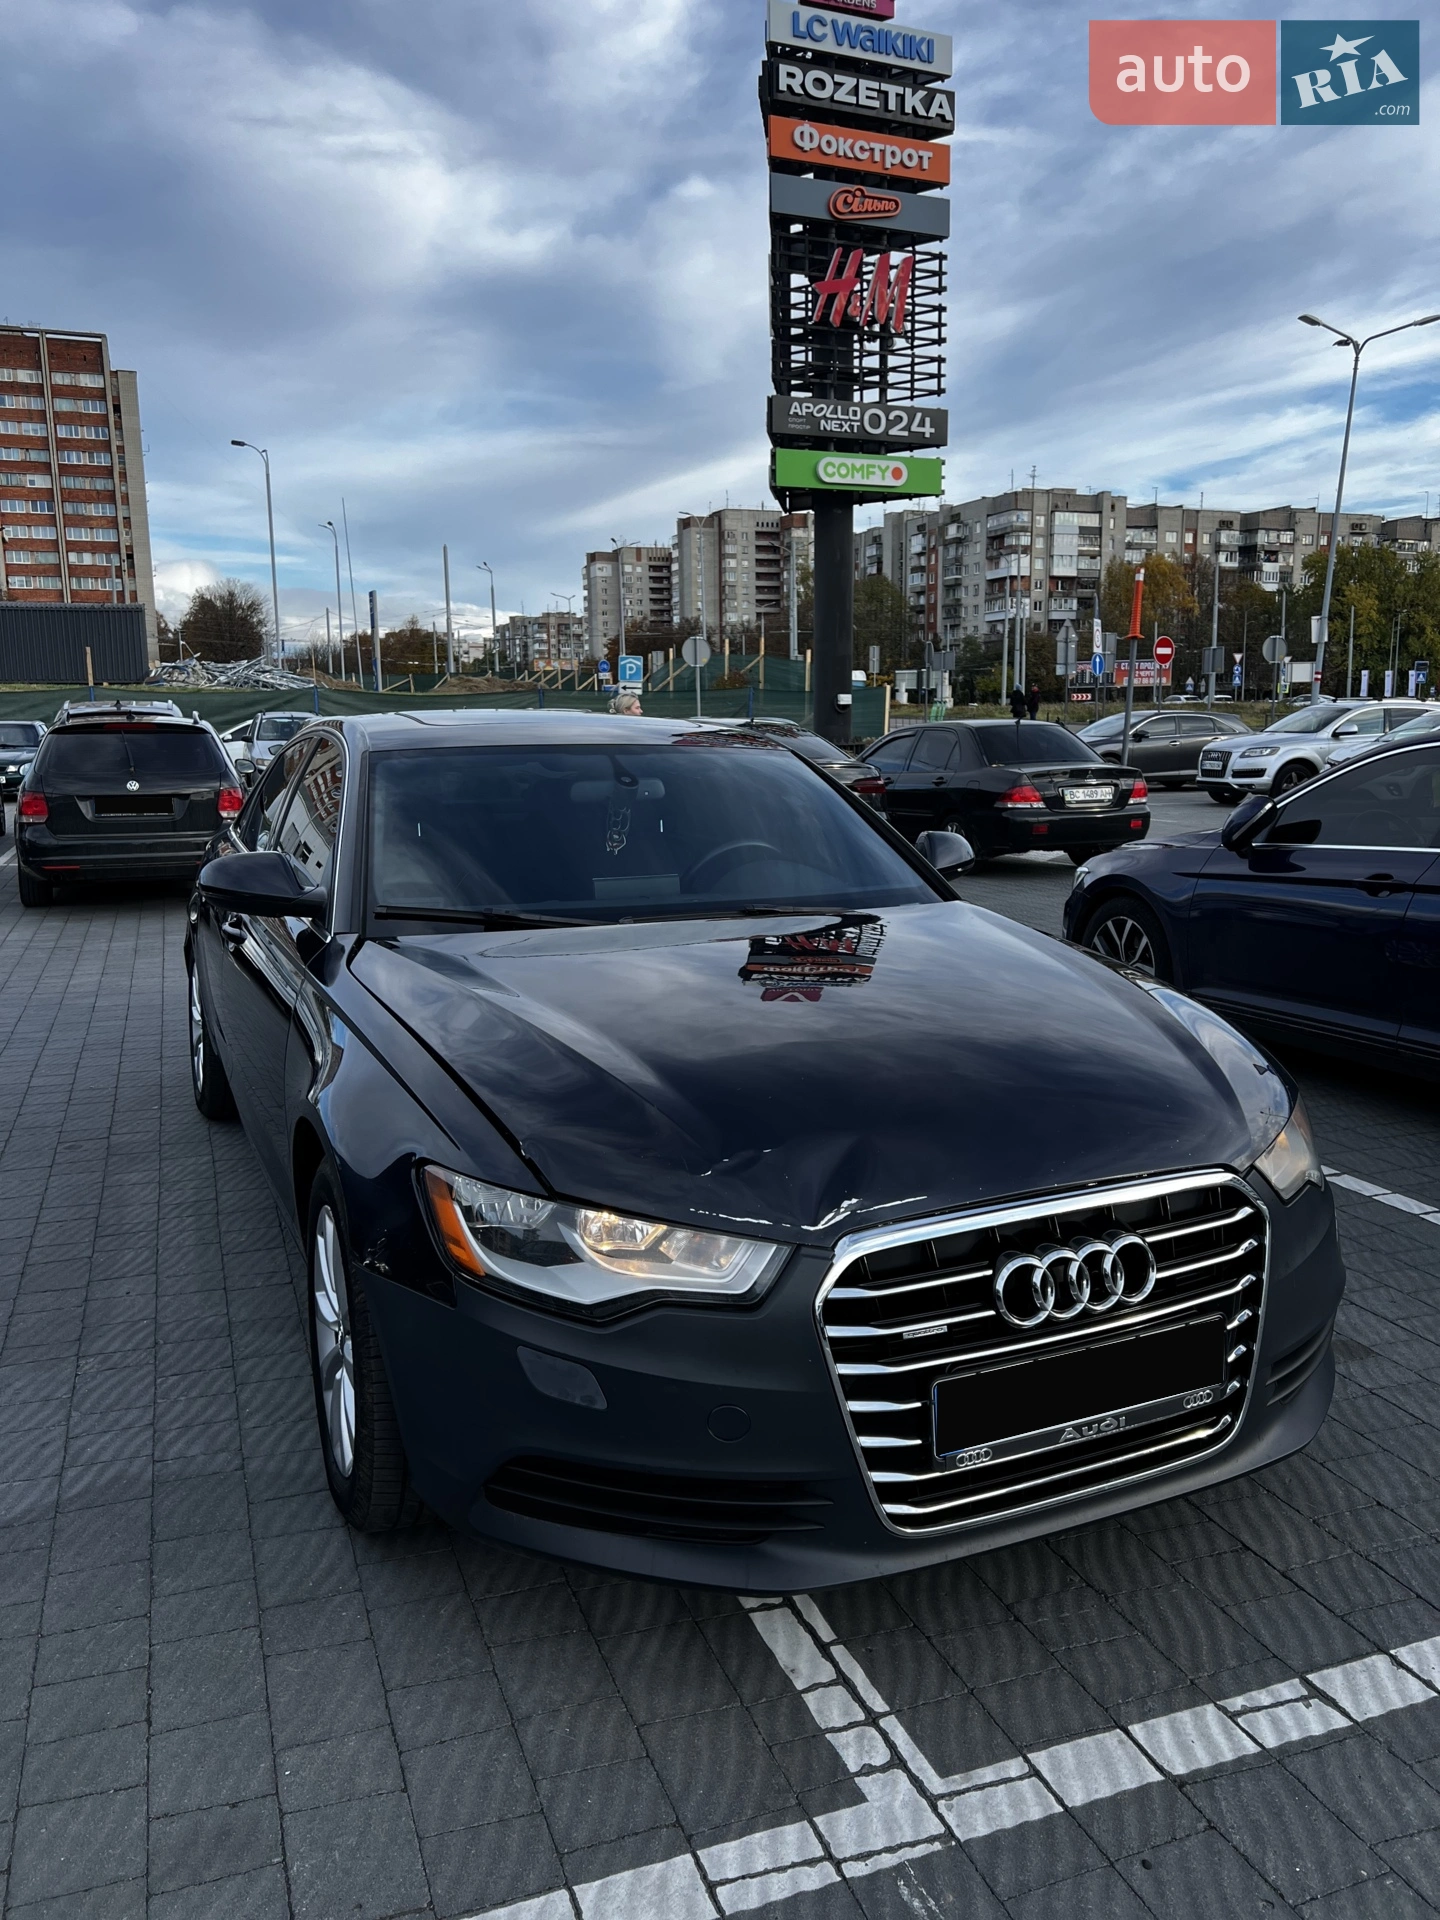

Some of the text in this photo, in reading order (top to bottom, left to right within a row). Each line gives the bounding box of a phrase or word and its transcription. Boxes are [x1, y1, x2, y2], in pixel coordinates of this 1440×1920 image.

[792, 10, 828, 43] LC
[778, 63, 954, 122] ROZETKA
[793, 122, 933, 170] Фокстрот
[811, 246, 914, 334] H&M
[789, 401, 861, 420] APOLLO
[820, 419, 861, 433] NEXT
[823, 461, 890, 481] COMFY
[626, 663, 637, 680] P
[1059, 1416, 1126, 1443] Audi
